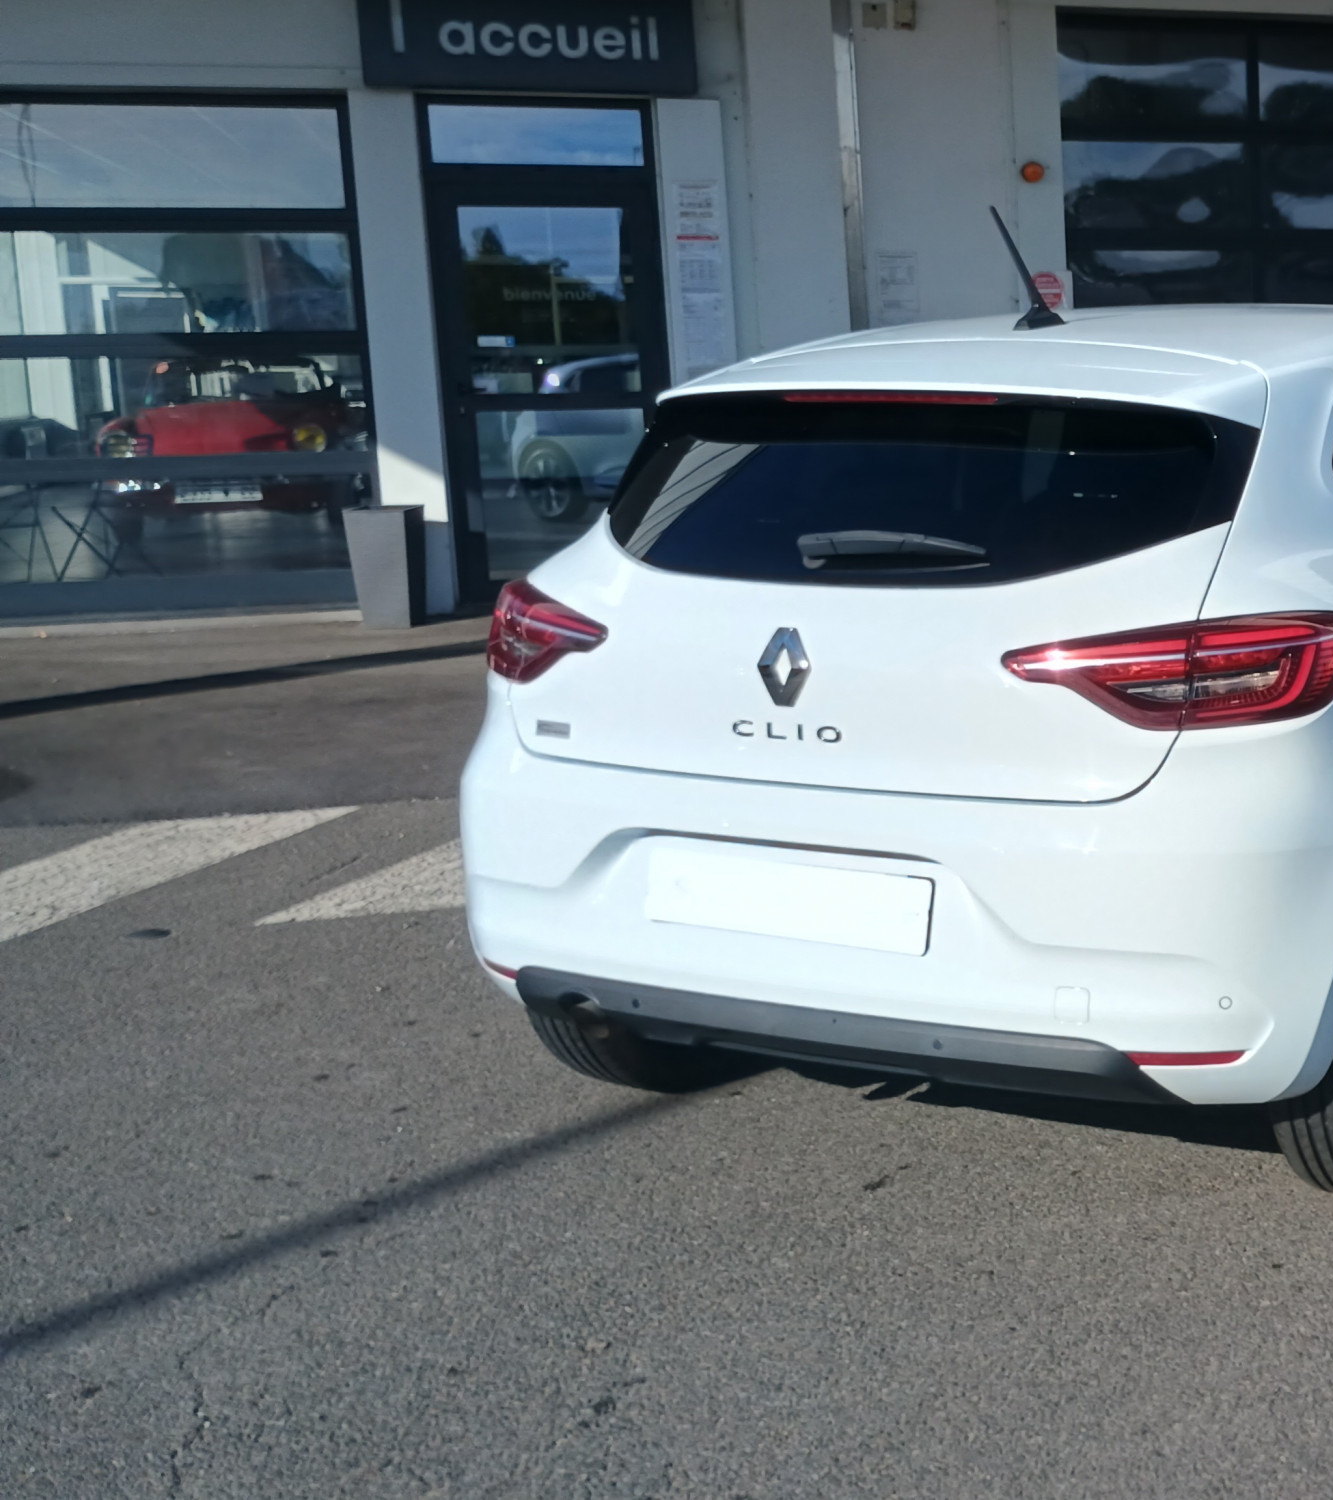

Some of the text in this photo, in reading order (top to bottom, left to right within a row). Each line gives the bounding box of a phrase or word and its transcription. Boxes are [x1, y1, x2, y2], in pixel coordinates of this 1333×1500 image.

[438, 16, 660, 62] accueil
[503, 286, 597, 301] bienvenue
[732, 720, 842, 743] CLIO
